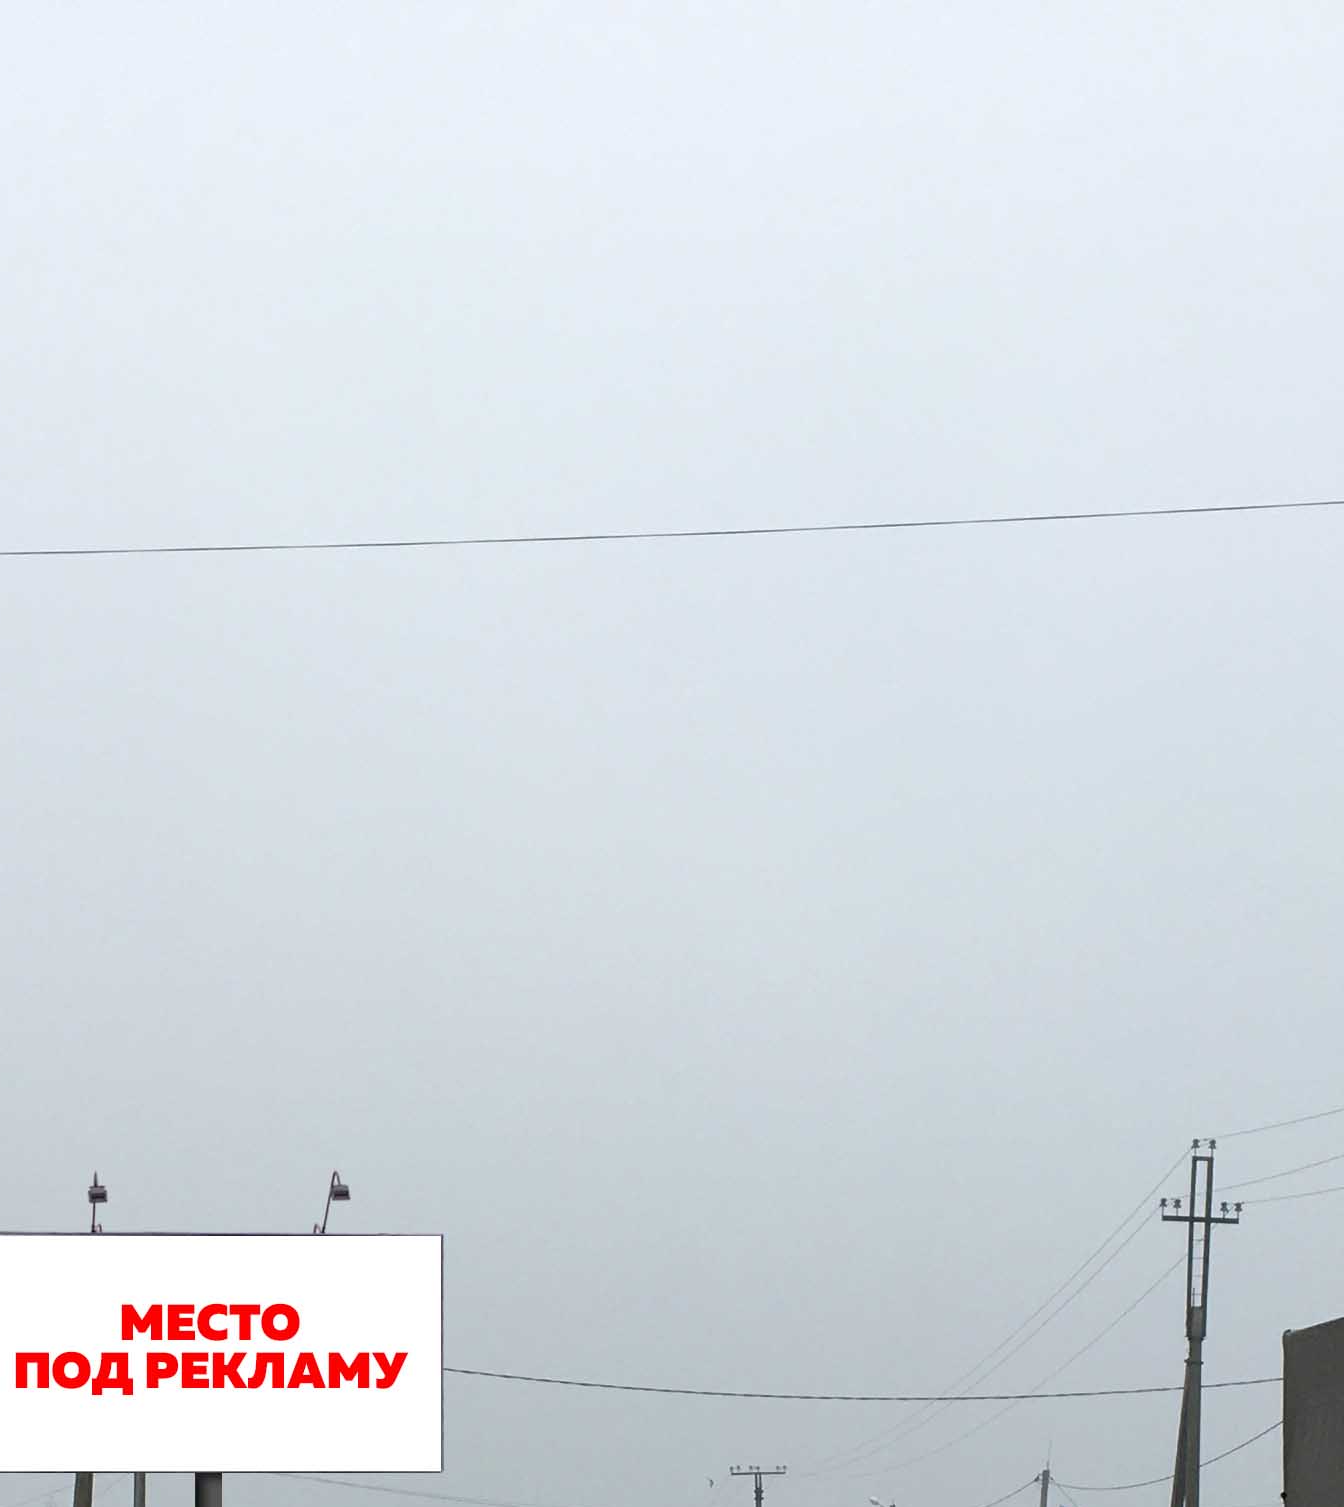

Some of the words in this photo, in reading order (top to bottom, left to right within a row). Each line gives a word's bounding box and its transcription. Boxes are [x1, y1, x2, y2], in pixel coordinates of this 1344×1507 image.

[121, 1303, 301, 1341] МЕСТО
[15, 1351, 134, 1396] ПОД
[146, 1351, 409, 1389] РЕКЛАМУ
